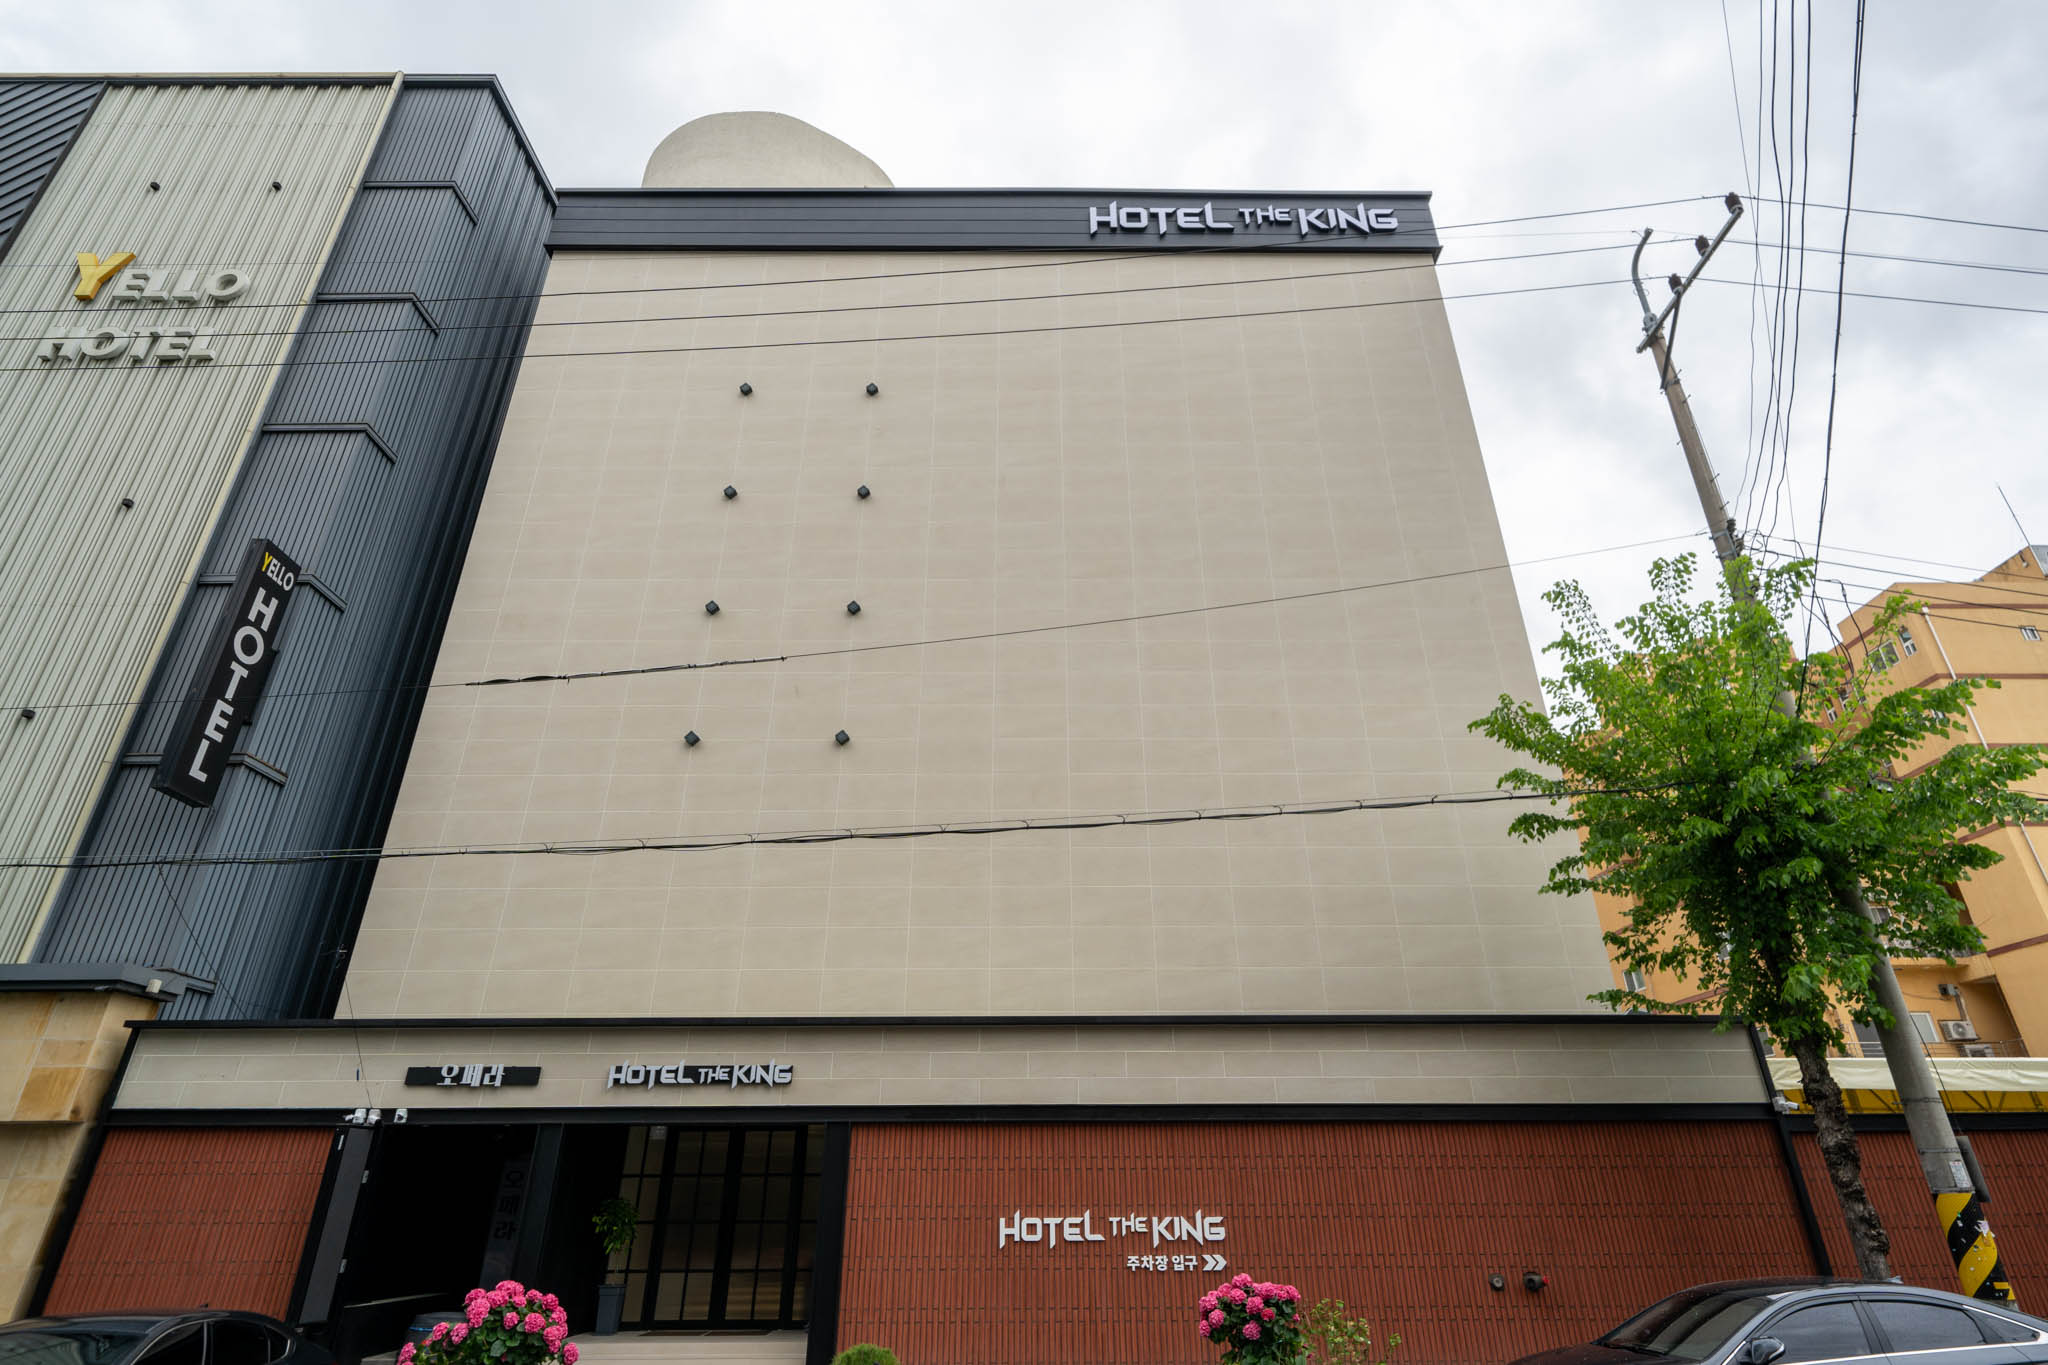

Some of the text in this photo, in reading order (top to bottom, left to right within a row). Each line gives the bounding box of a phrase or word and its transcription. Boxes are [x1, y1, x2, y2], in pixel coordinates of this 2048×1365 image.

[1089, 200, 1398, 236] HOTEL THE KING
[74, 251, 250, 301] YELLO
[37, 325, 216, 361] HOTEL
[261, 552, 295, 591] YELLO
[188, 587, 279, 783] HOTEL
[436, 1063, 506, 1087] 오페라
[607, 1058, 793, 1089] HOTEL THE KING
[999, 1209, 1226, 1249] HOTEL THE KING
[1126, 1255, 1198, 1272] 주차장 입구
